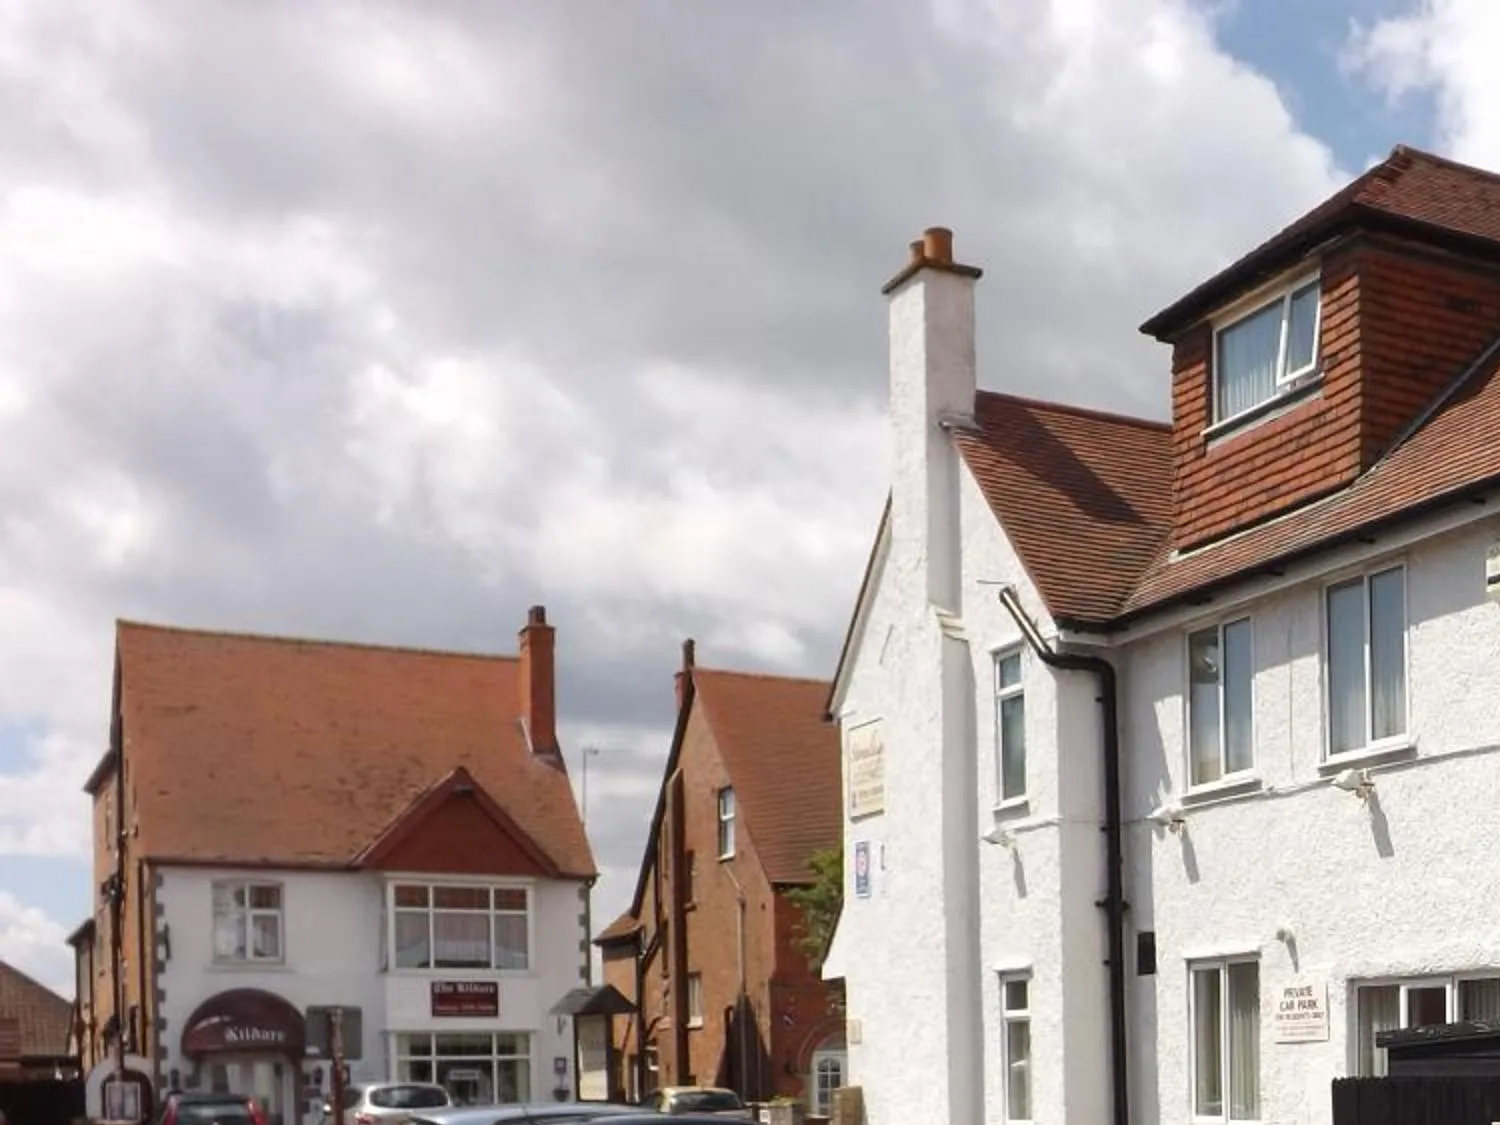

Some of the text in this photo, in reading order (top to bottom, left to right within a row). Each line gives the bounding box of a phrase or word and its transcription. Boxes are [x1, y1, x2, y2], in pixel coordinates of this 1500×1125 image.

[1283, 986, 1313, 998] PRIVATE
[1279, 999, 1318, 1012] CAR PARK
